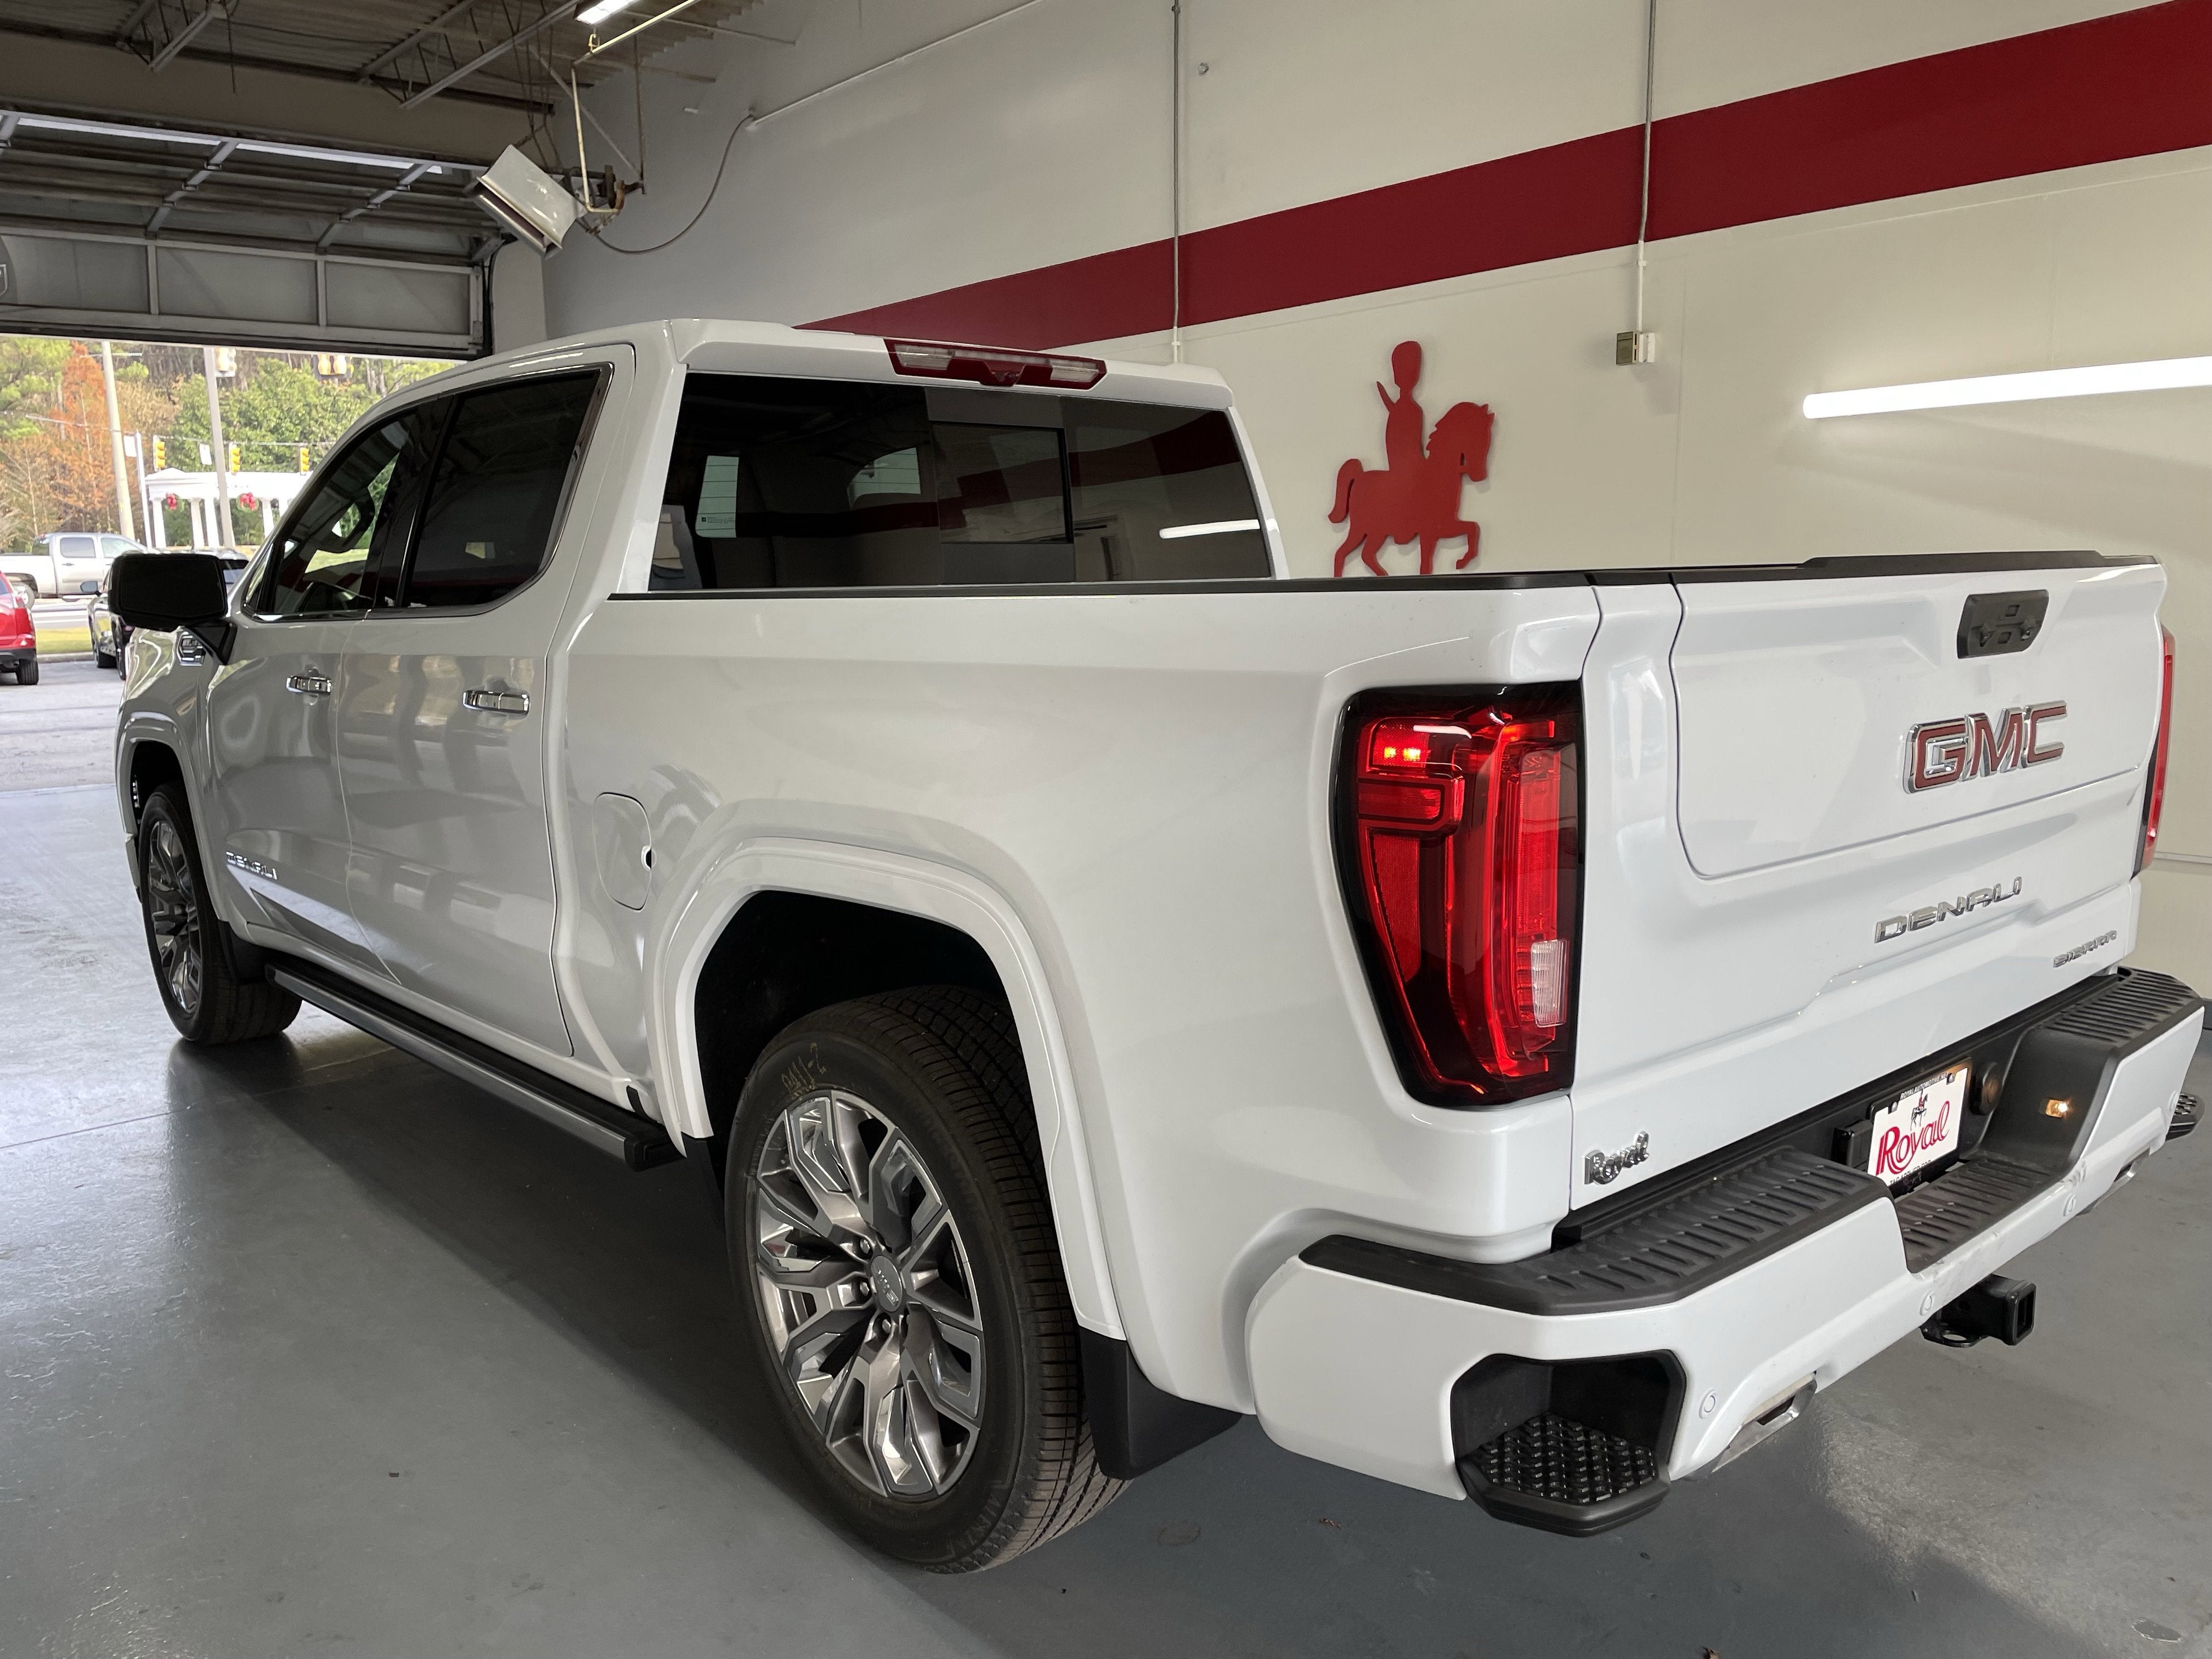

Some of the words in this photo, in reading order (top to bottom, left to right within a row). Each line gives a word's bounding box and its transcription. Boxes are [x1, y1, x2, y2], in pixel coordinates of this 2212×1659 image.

[1903, 700, 2067, 794] GMC
[226, 851, 277, 880] DENALI
[1875, 876, 2023, 943] DENALI
[2053, 930, 2117, 968] SIERRA
[1875, 1101, 1949, 1175] Royal
